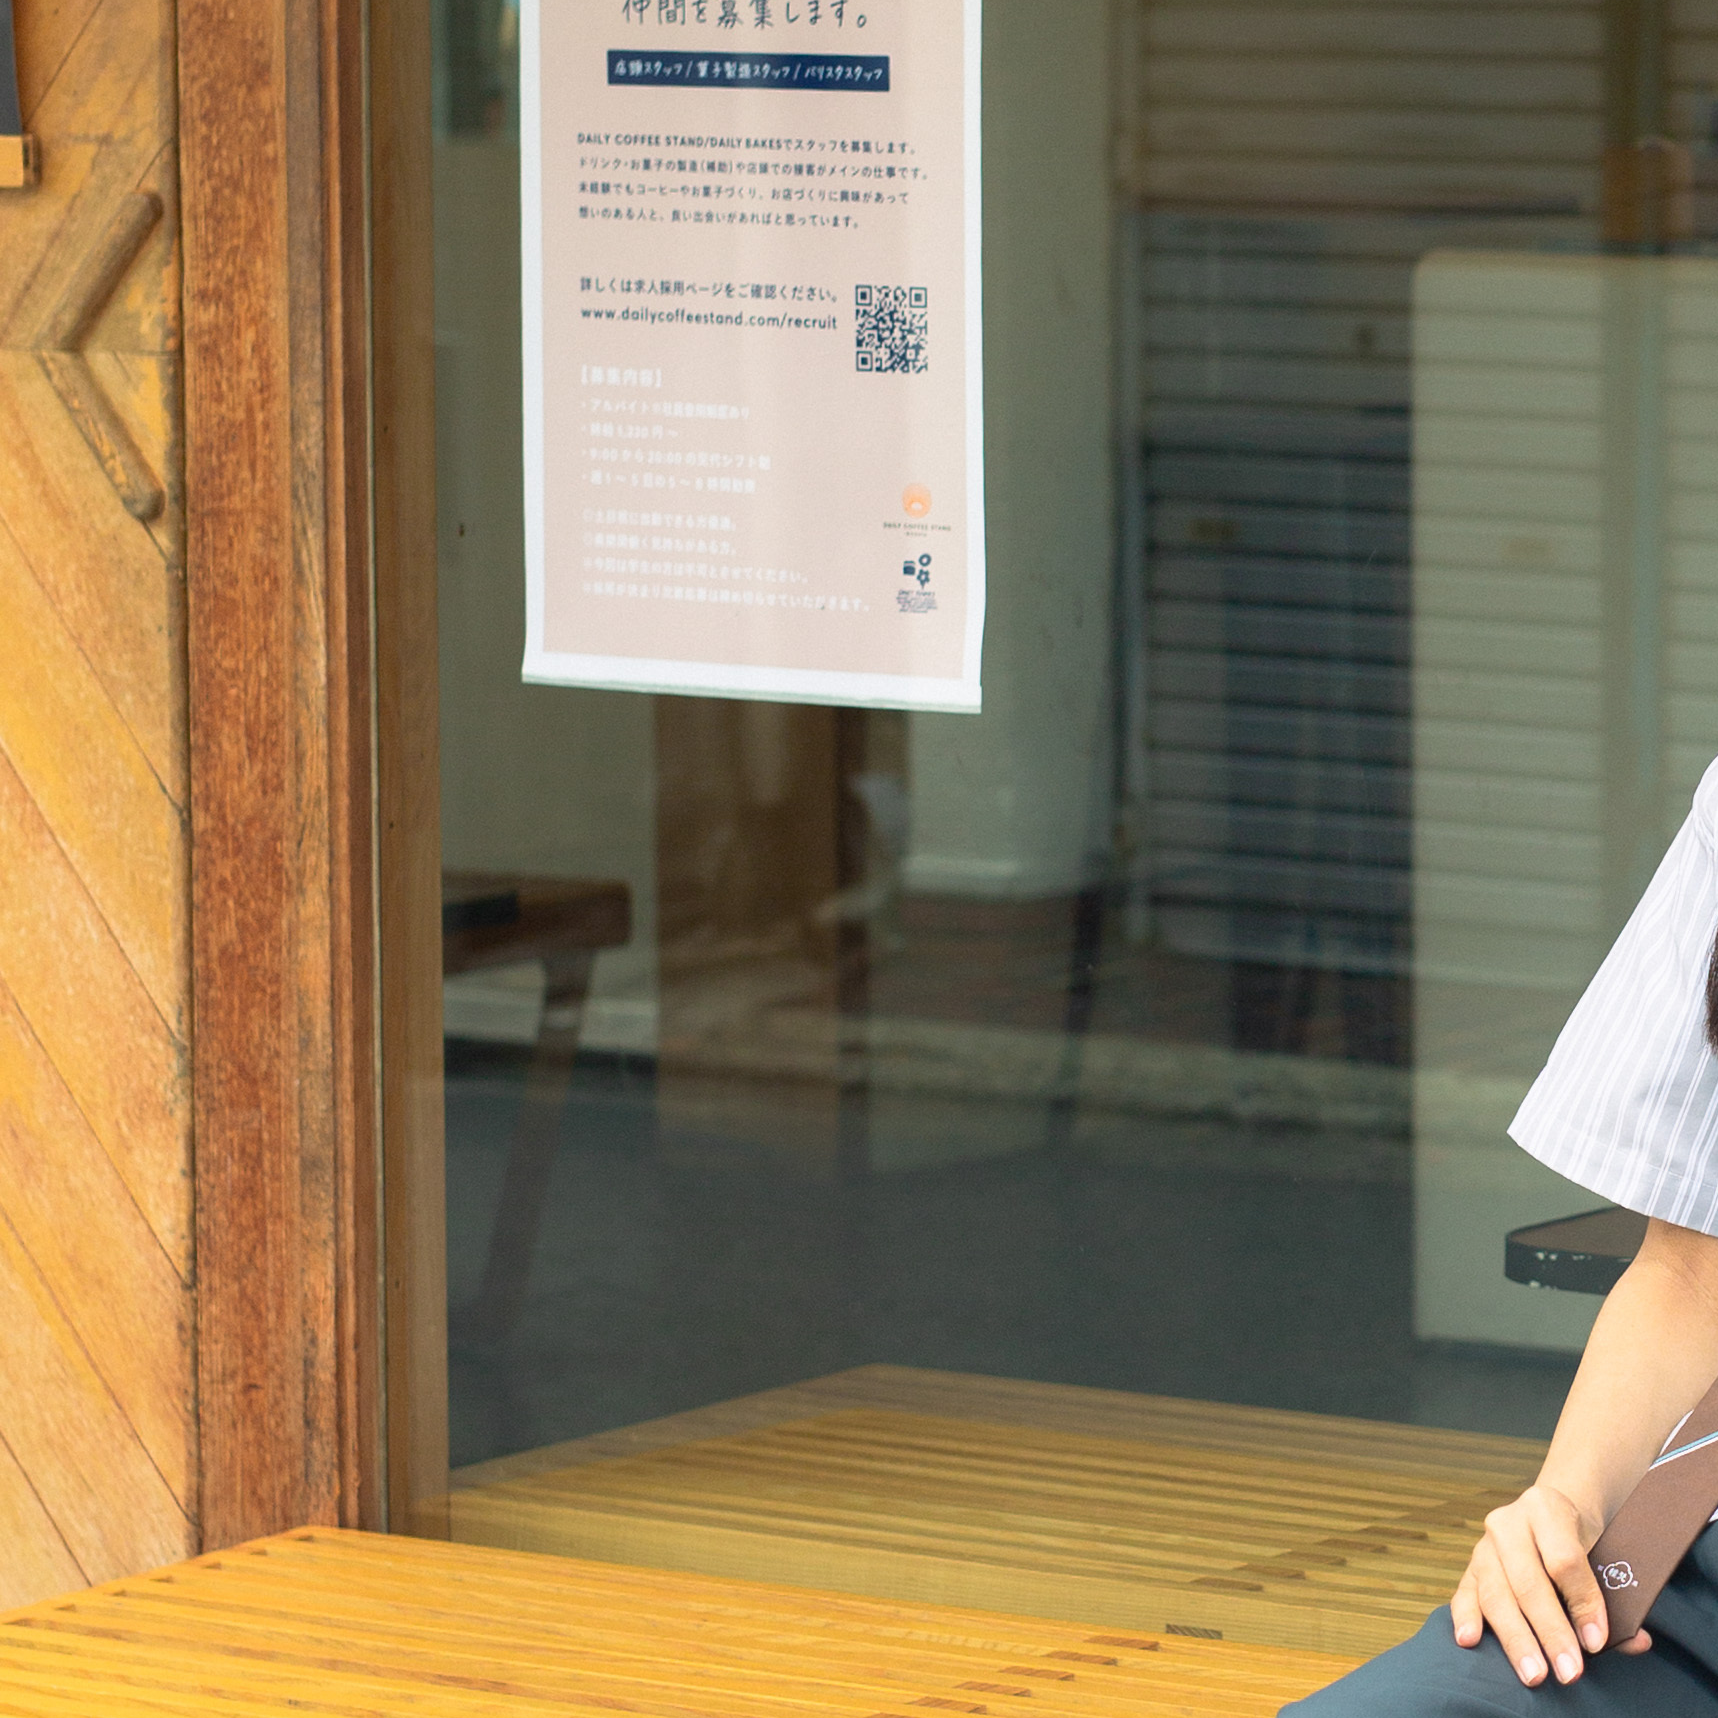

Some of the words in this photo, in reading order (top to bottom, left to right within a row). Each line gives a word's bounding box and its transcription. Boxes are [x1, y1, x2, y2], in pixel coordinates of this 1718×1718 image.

[577, 132, 611, 146] DAILY
[614, 133, 661, 147] COFFEE
[580, 276, 838, 303] 詳しくは求人採用ページをご確認ください。
[580, 306, 838, 331] www.dailycoffeestand.com/recruit
